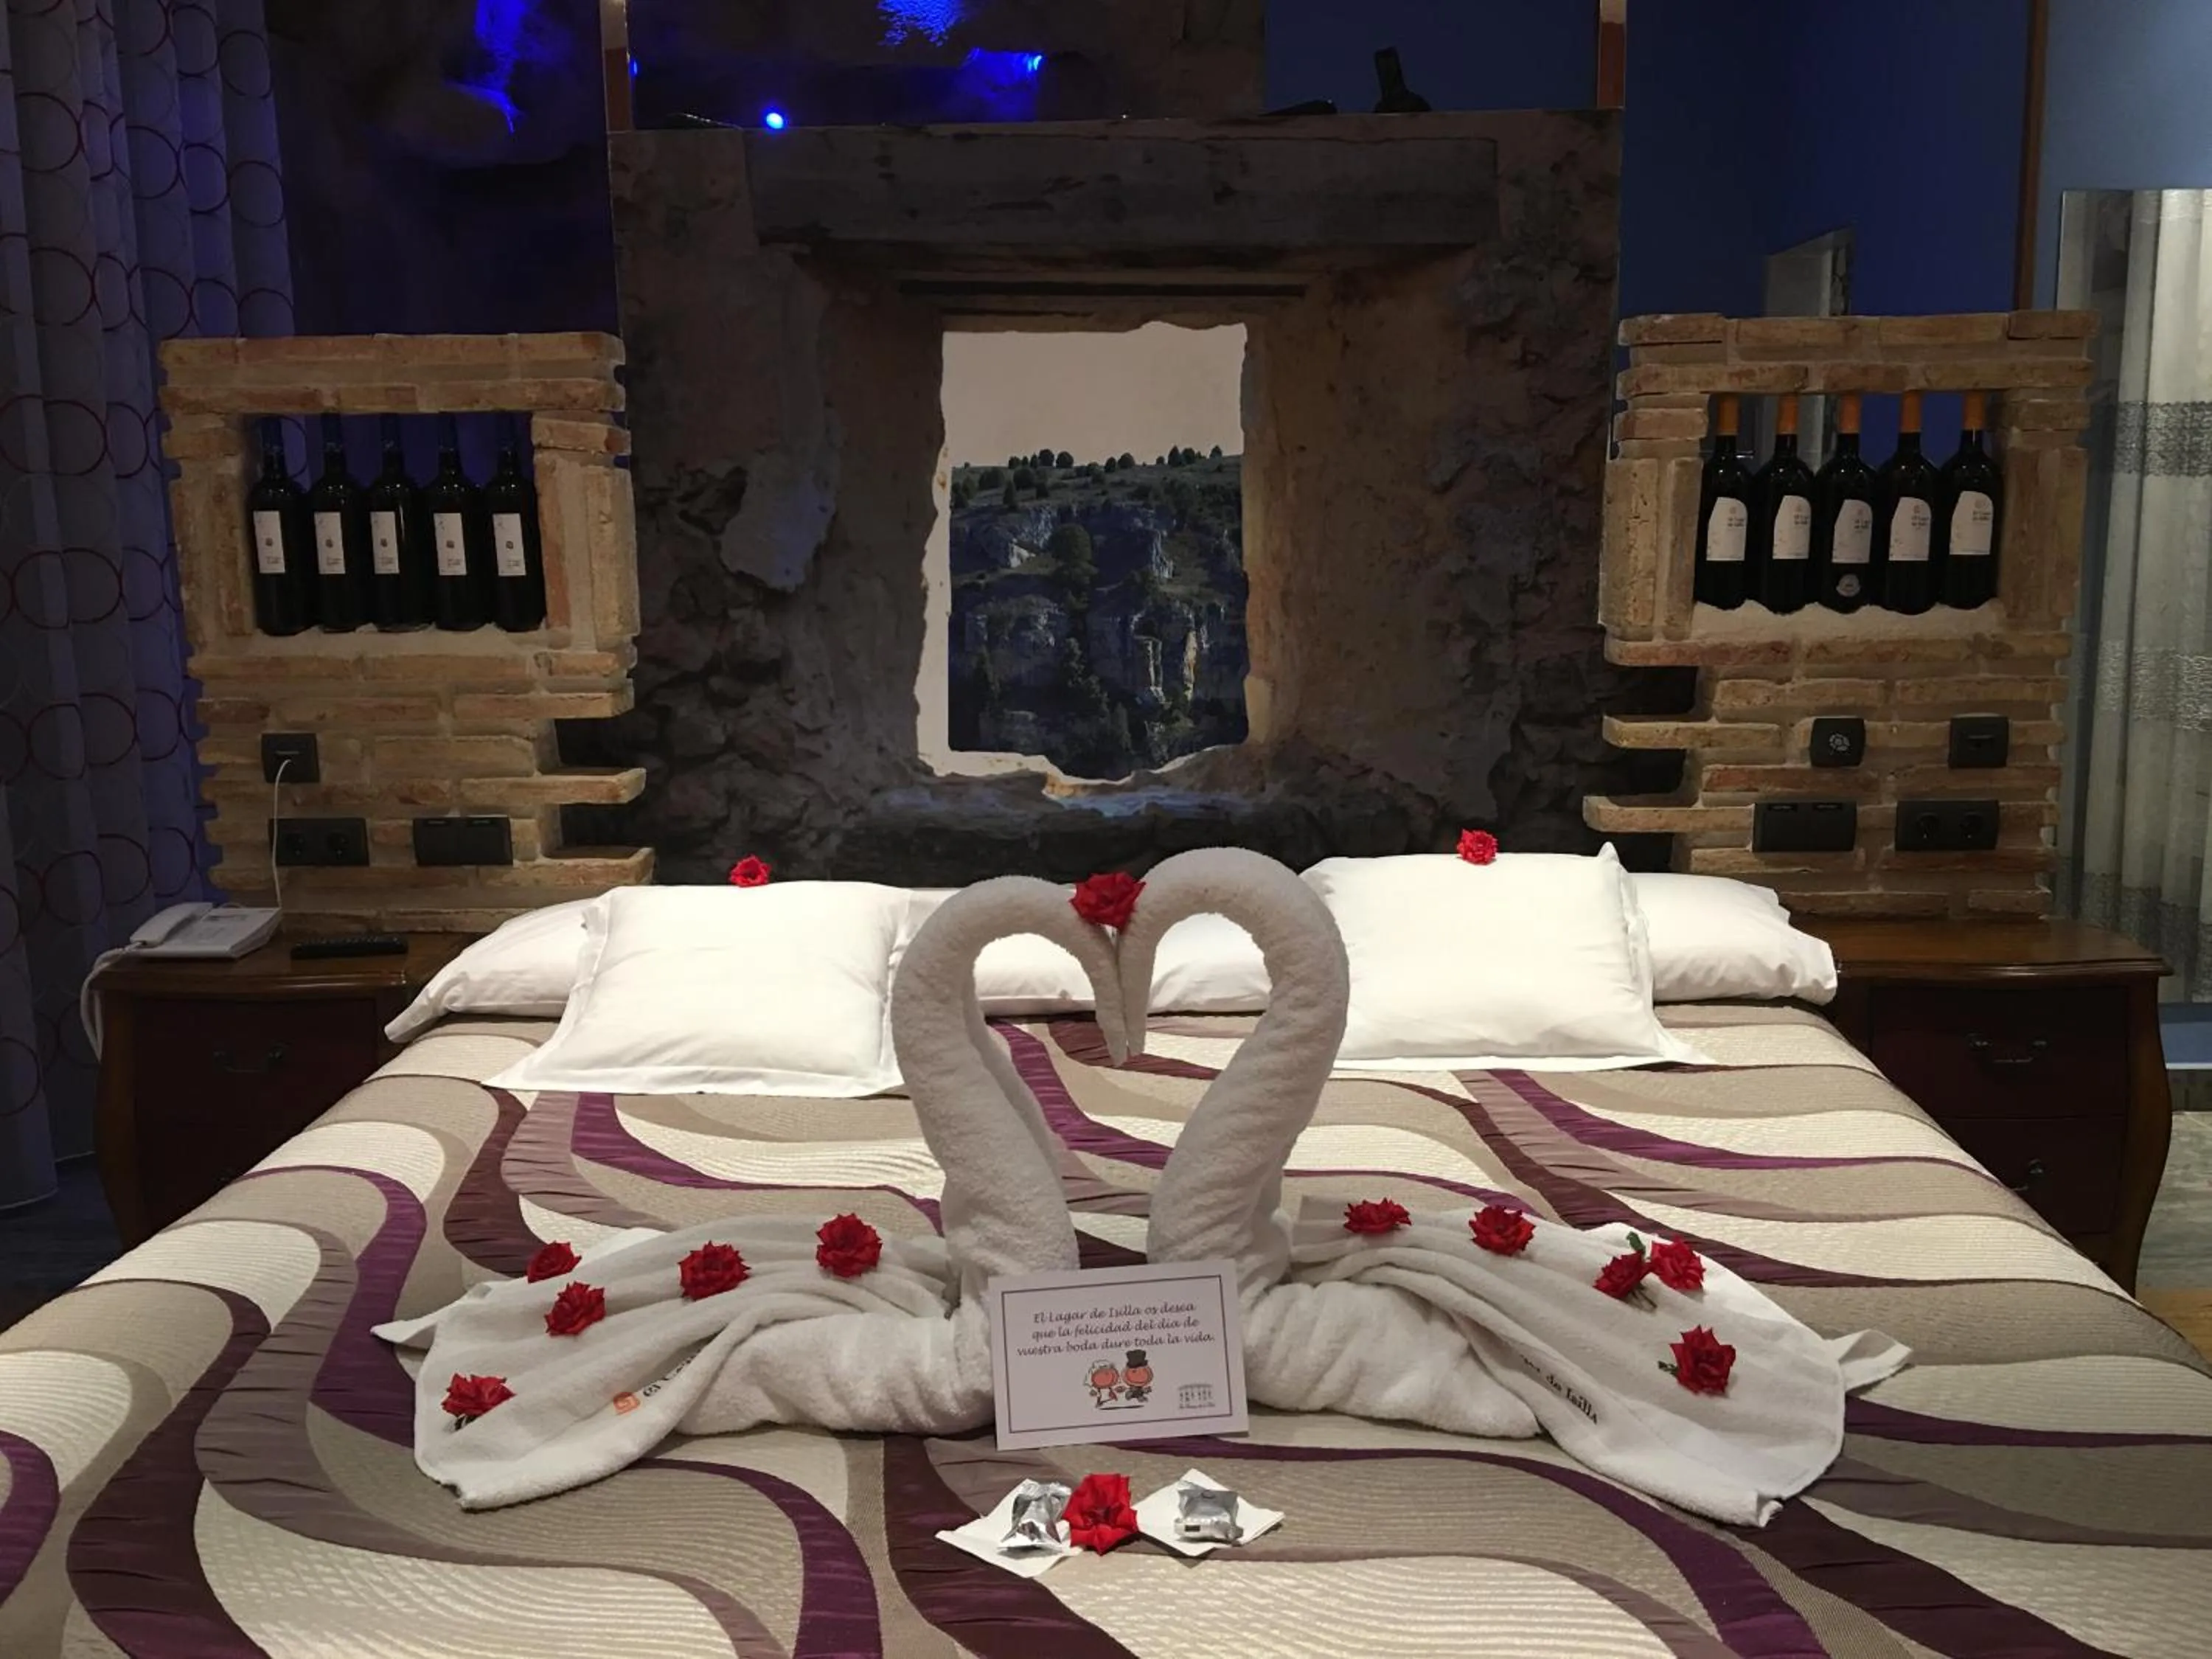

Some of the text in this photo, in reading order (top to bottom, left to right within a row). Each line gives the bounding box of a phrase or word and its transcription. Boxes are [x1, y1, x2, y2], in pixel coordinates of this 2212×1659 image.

[1034, 1312, 1046, 1324] El
[1049, 1311, 1087, 1324] Lagar
[1089, 1307, 1106, 1318] de
[1144, 1306, 1157, 1315] os
[1160, 1301, 1196, 1313] desea
[1032, 1330, 1056, 1343] que
[1058, 1326, 1071, 1337] la
[1074, 1321, 1130, 1338] felicidad
[1134, 1319, 1154, 1330] del
[1183, 1315, 1200, 1327] de
[1017, 1345, 1062, 1356] vuestra
[1066, 1340, 1097, 1352] boda
[1101, 1338, 1131, 1349] dure
[1134, 1334, 1164, 1346] toda
[1167, 1332, 1180, 1344] la
